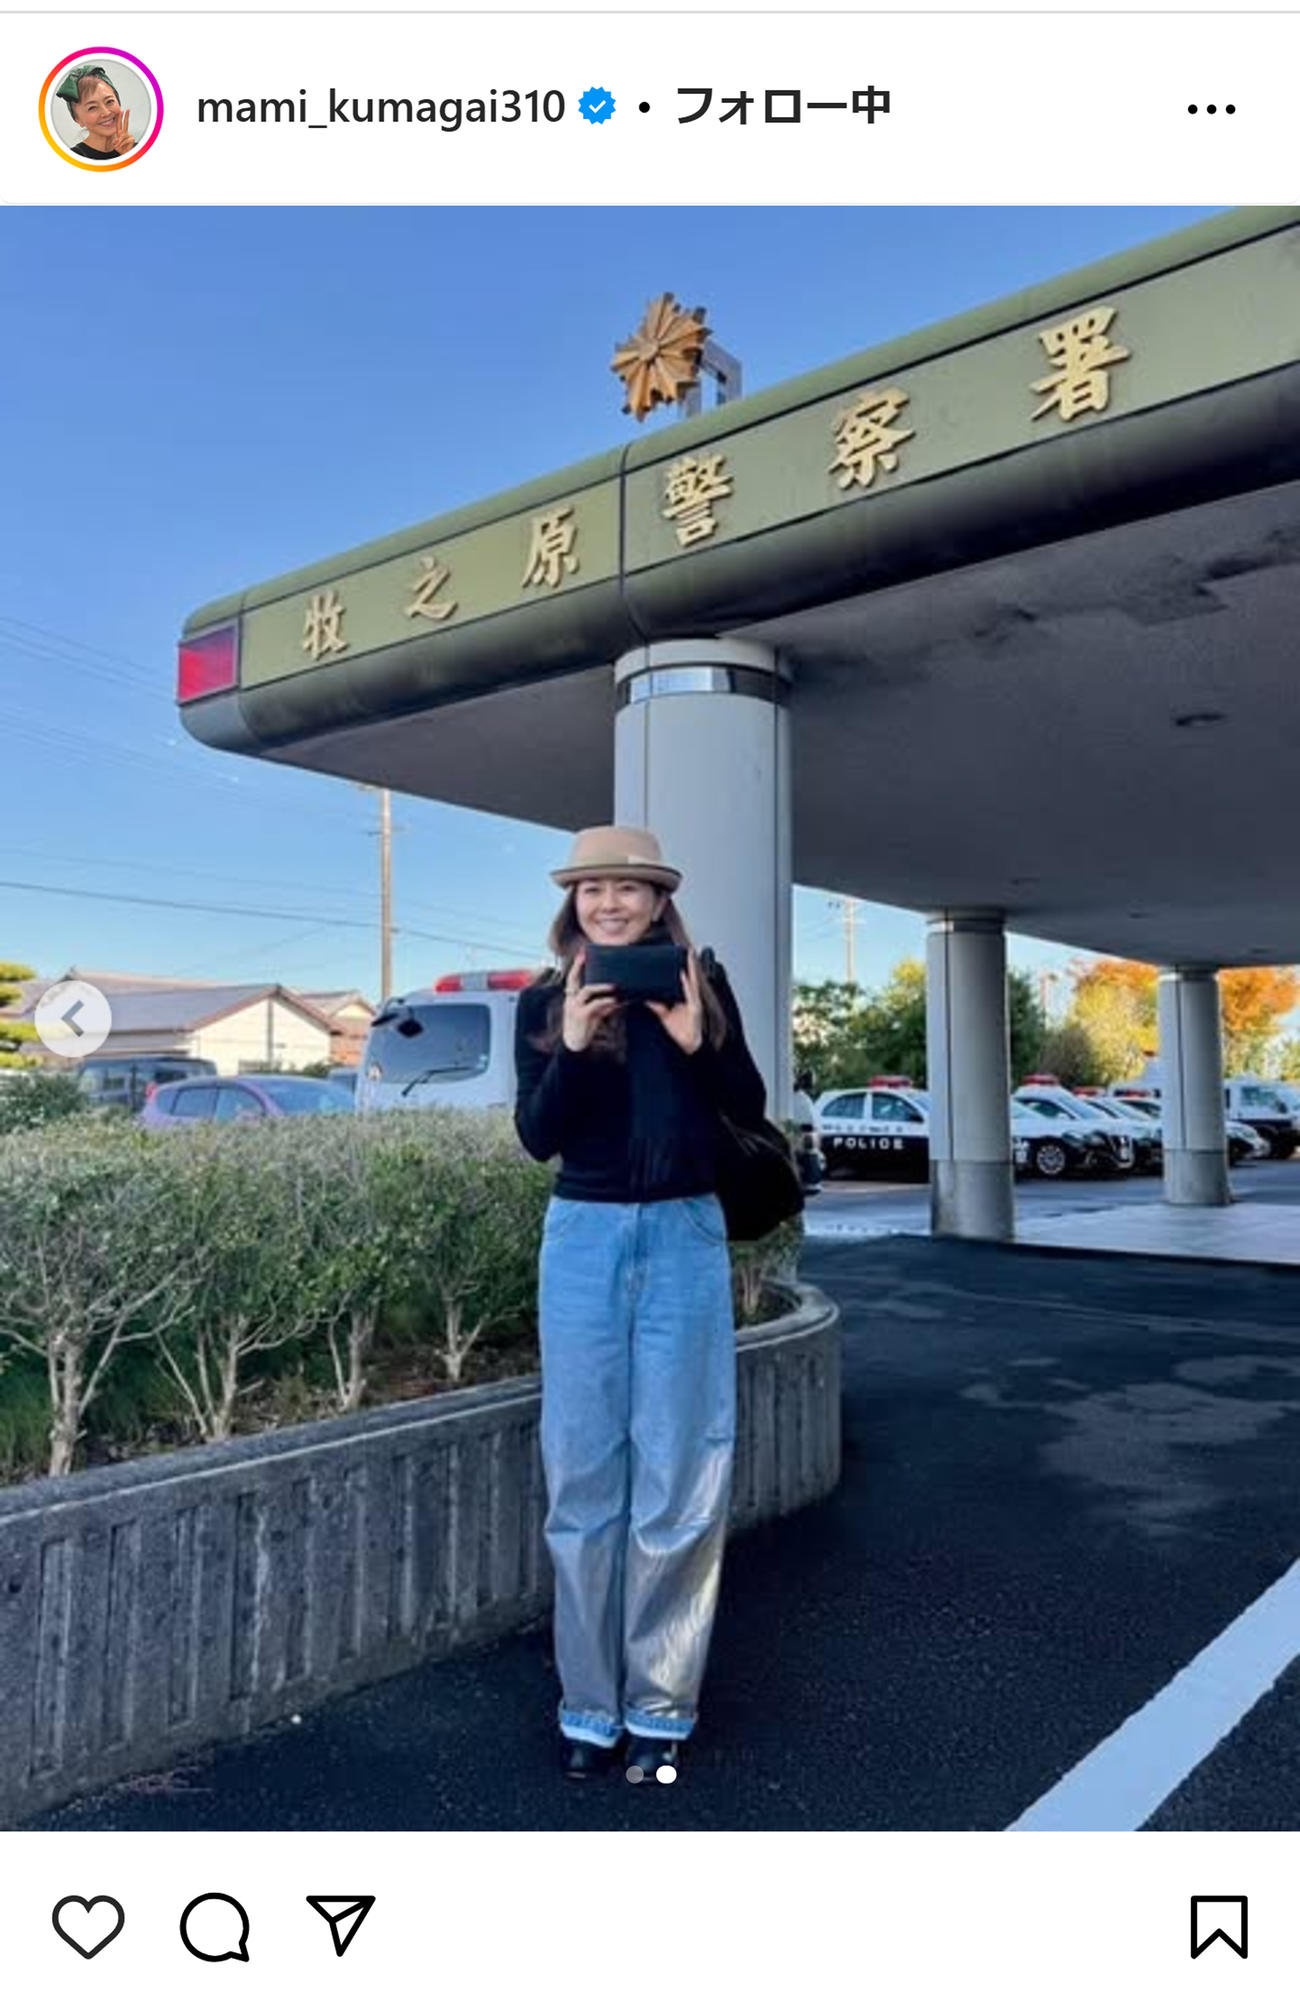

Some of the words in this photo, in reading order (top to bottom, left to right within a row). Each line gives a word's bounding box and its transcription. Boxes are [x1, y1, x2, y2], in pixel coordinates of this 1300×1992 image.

[302, 305, 1131, 660] 牧之原警察署
[833, 1137, 905, 1150] POLICE
